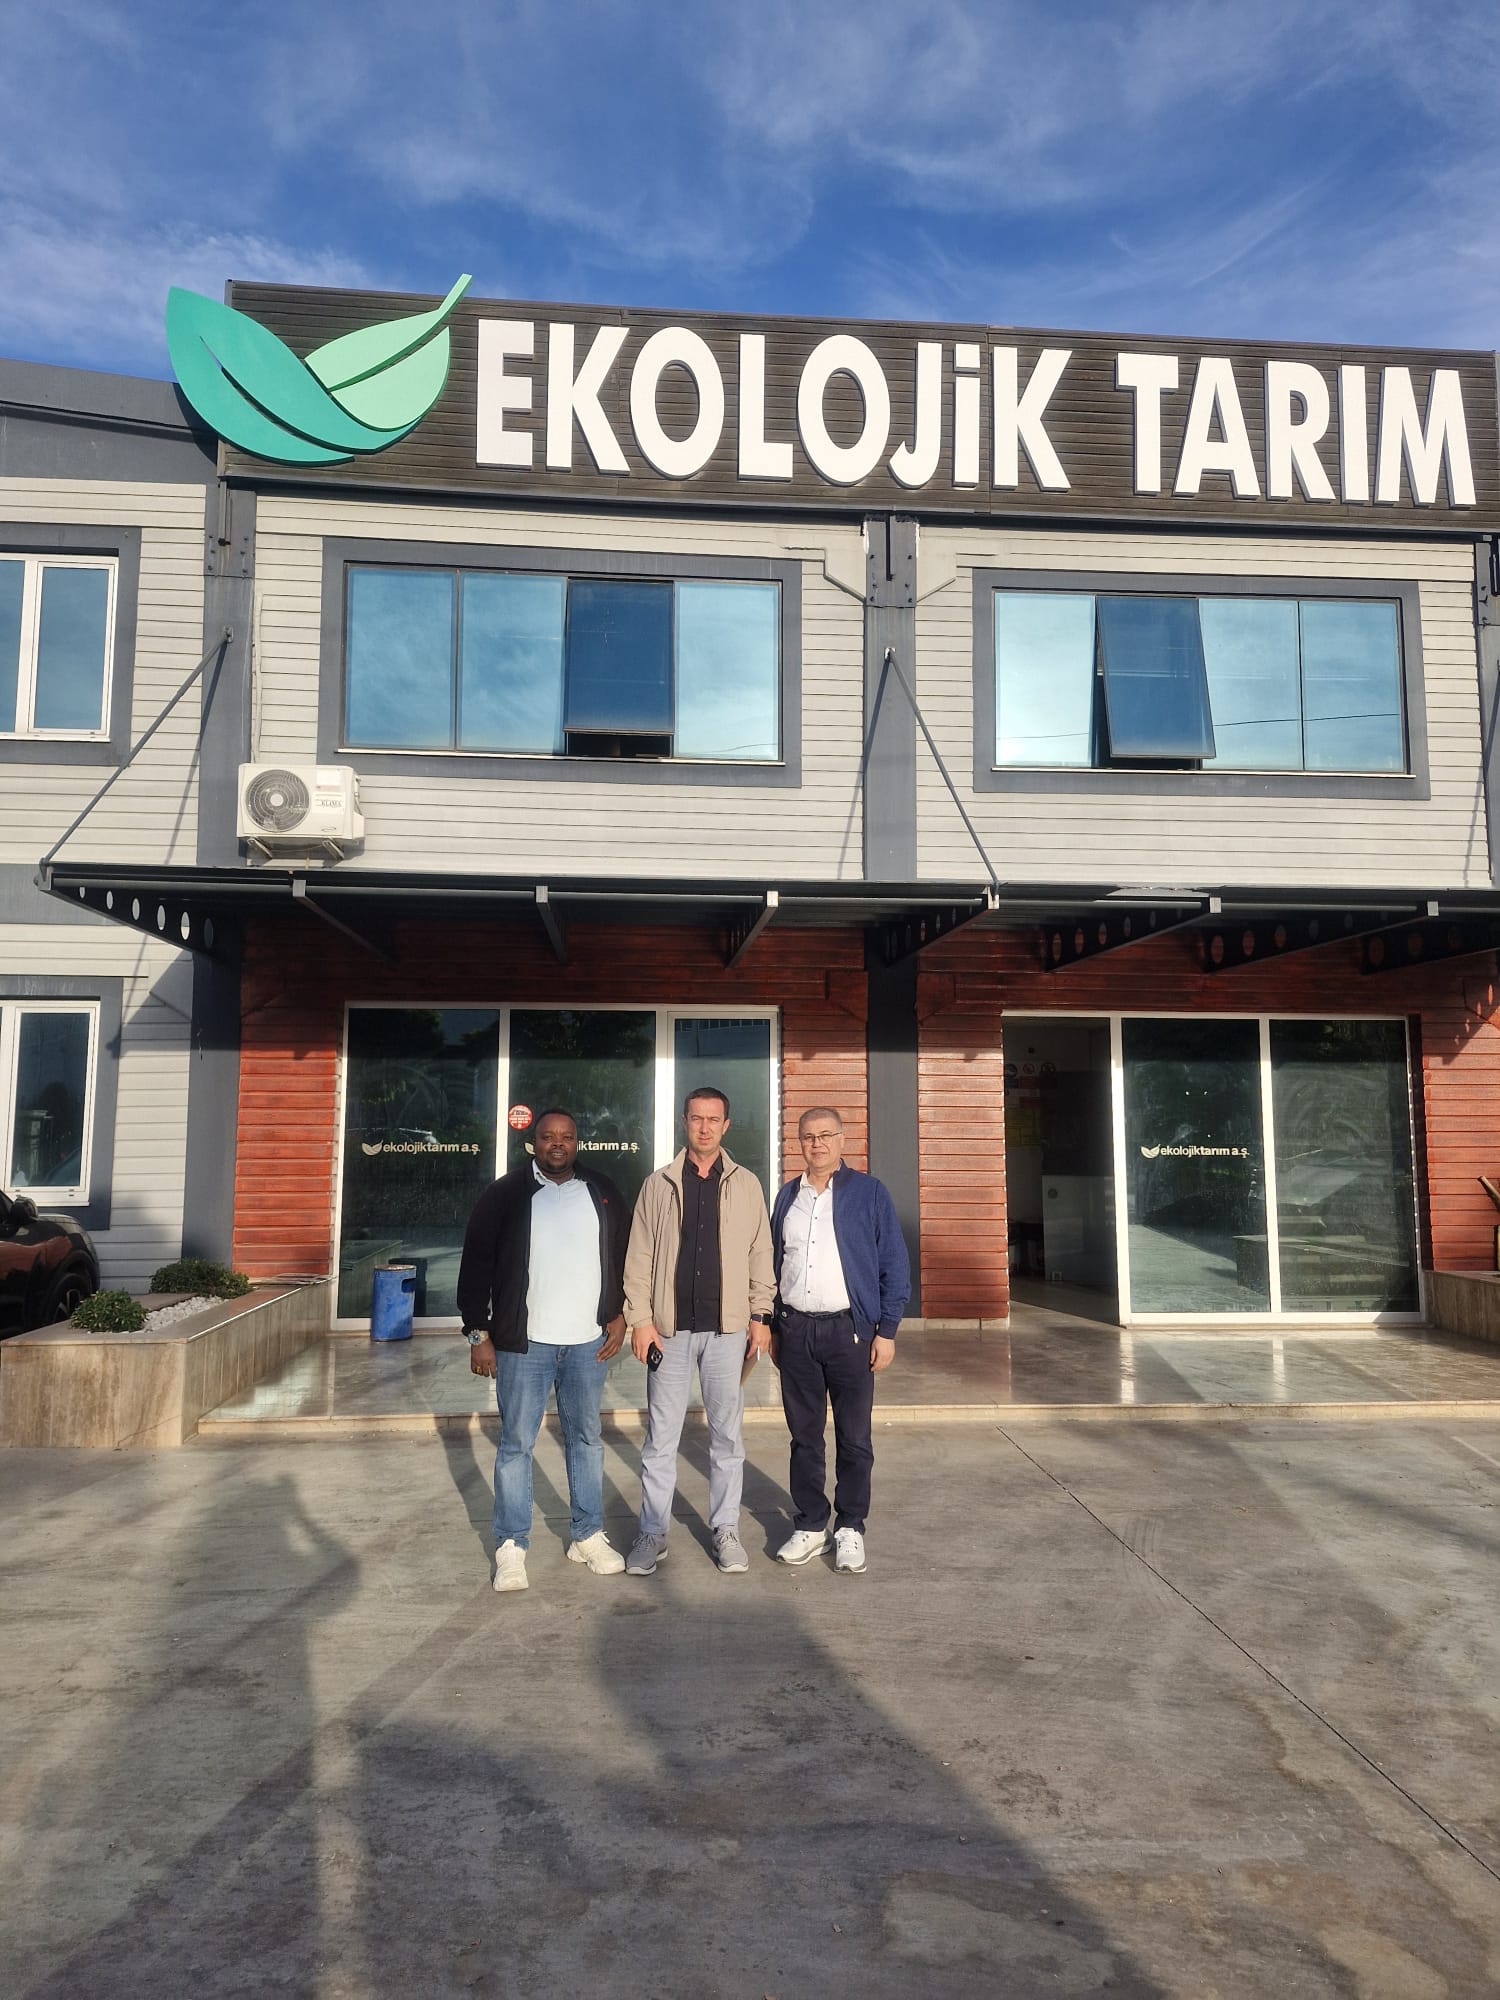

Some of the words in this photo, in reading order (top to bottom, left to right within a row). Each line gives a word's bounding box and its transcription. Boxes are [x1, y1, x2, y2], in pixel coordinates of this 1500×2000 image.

[1115, 353, 1477, 508] TARIM
[383, 1141, 459, 1155] ekolojiktarım
[1160, 1145, 1230, 1158] ekolojiktarım
